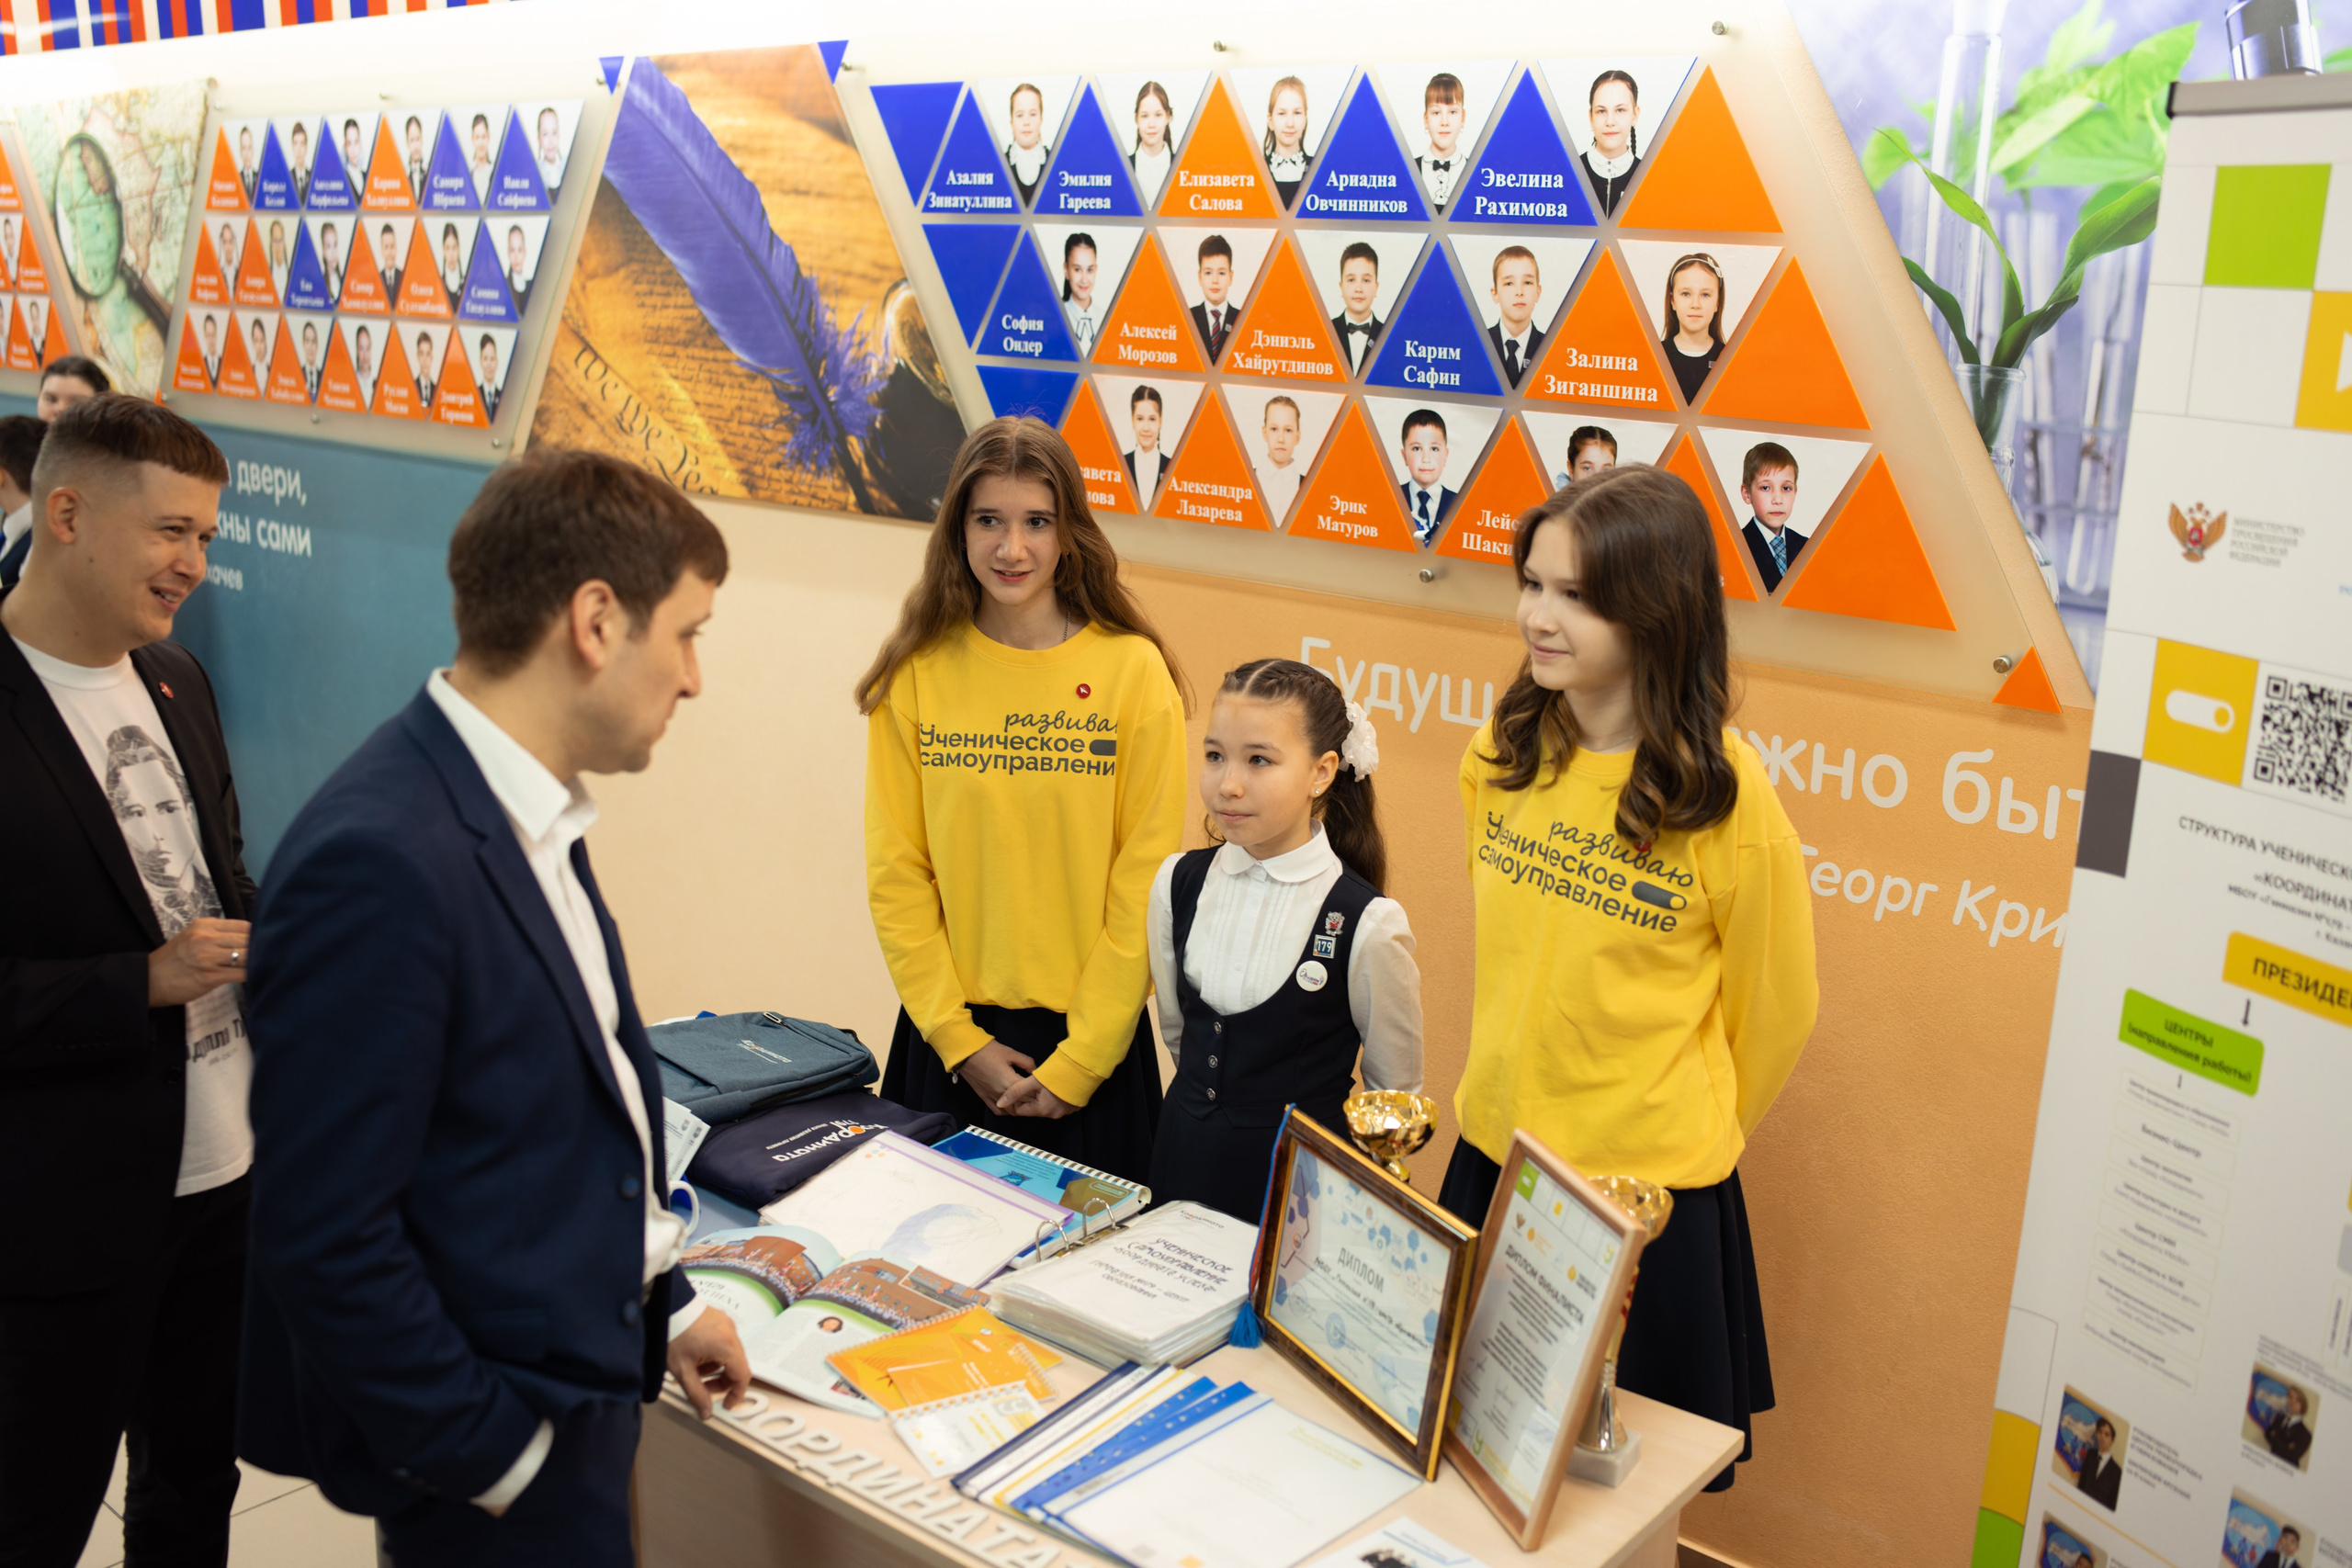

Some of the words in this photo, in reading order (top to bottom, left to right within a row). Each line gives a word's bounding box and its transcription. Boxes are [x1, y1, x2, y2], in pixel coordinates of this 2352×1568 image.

[945, 169, 994, 186] Азалия
[1058, 171, 1113, 188] Эмилия
[1178, 170, 1255, 188] Елизавета
[1326, 169, 1397, 190] Ариадна
[1480, 167, 1564, 189] Эвелина
[928, 191, 1012, 212] Зинатуллина
[1058, 193, 1112, 213] Гареева
[1189, 194, 1243, 212] Салова
[1306, 193, 1408, 214] Овчинников
[1475, 196, 1568, 219] Рахимова
[1001, 314, 1045, 335] София
[1119, 320, 1178, 342] Алексей
[1002, 336, 1043, 356] Ондер
[1250, 329, 1315, 351] Дэниэль
[1118, 343, 1177, 366] Морозов
[1404, 340, 1461, 364] Карим
[1566, 347, 1638, 372] Залина
[1232, 351, 1334, 377] Хайрутдинов
[1403, 365, 1461, 389] Сафин
[1544, 374, 1658, 402] Зиганшина
[236, 459, 308, 507] двери,
[1080, 465, 1123, 484] авета
[1168, 475, 1253, 502] Александра
[1176, 499, 1243, 523] Лазарева
[1329, 495, 1368, 516] Эрик
[1317, 514, 1379, 539] Матуров
[1476, 509, 1525, 532] Лейс
[256, 517, 312, 558] сами
[920, 722, 1086, 753] Ученическое
[1724, 726, 1908, 809] жно
[2178, 815, 2256, 852] СТРУКТУРА
[1548, 820, 1694, 888] развиваю
[1478, 843, 1678, 933] самоуправление
[2227, 883, 2257, 900] МБОУ
[1317, 940, 1333, 953] 179
[2164, 1018, 2214, 1049] ЦЕНТРЫ
[2127, 1021, 2201, 1064] (направления
[2201, 1051, 2253, 1085] работы)
[1337, 1247, 1385, 1294] ДИПЛОМ
[1504, 1243, 1540, 1282] ДИПЛОМ
[1537, 1273, 1586, 1325] ФИНАЛИСТА
